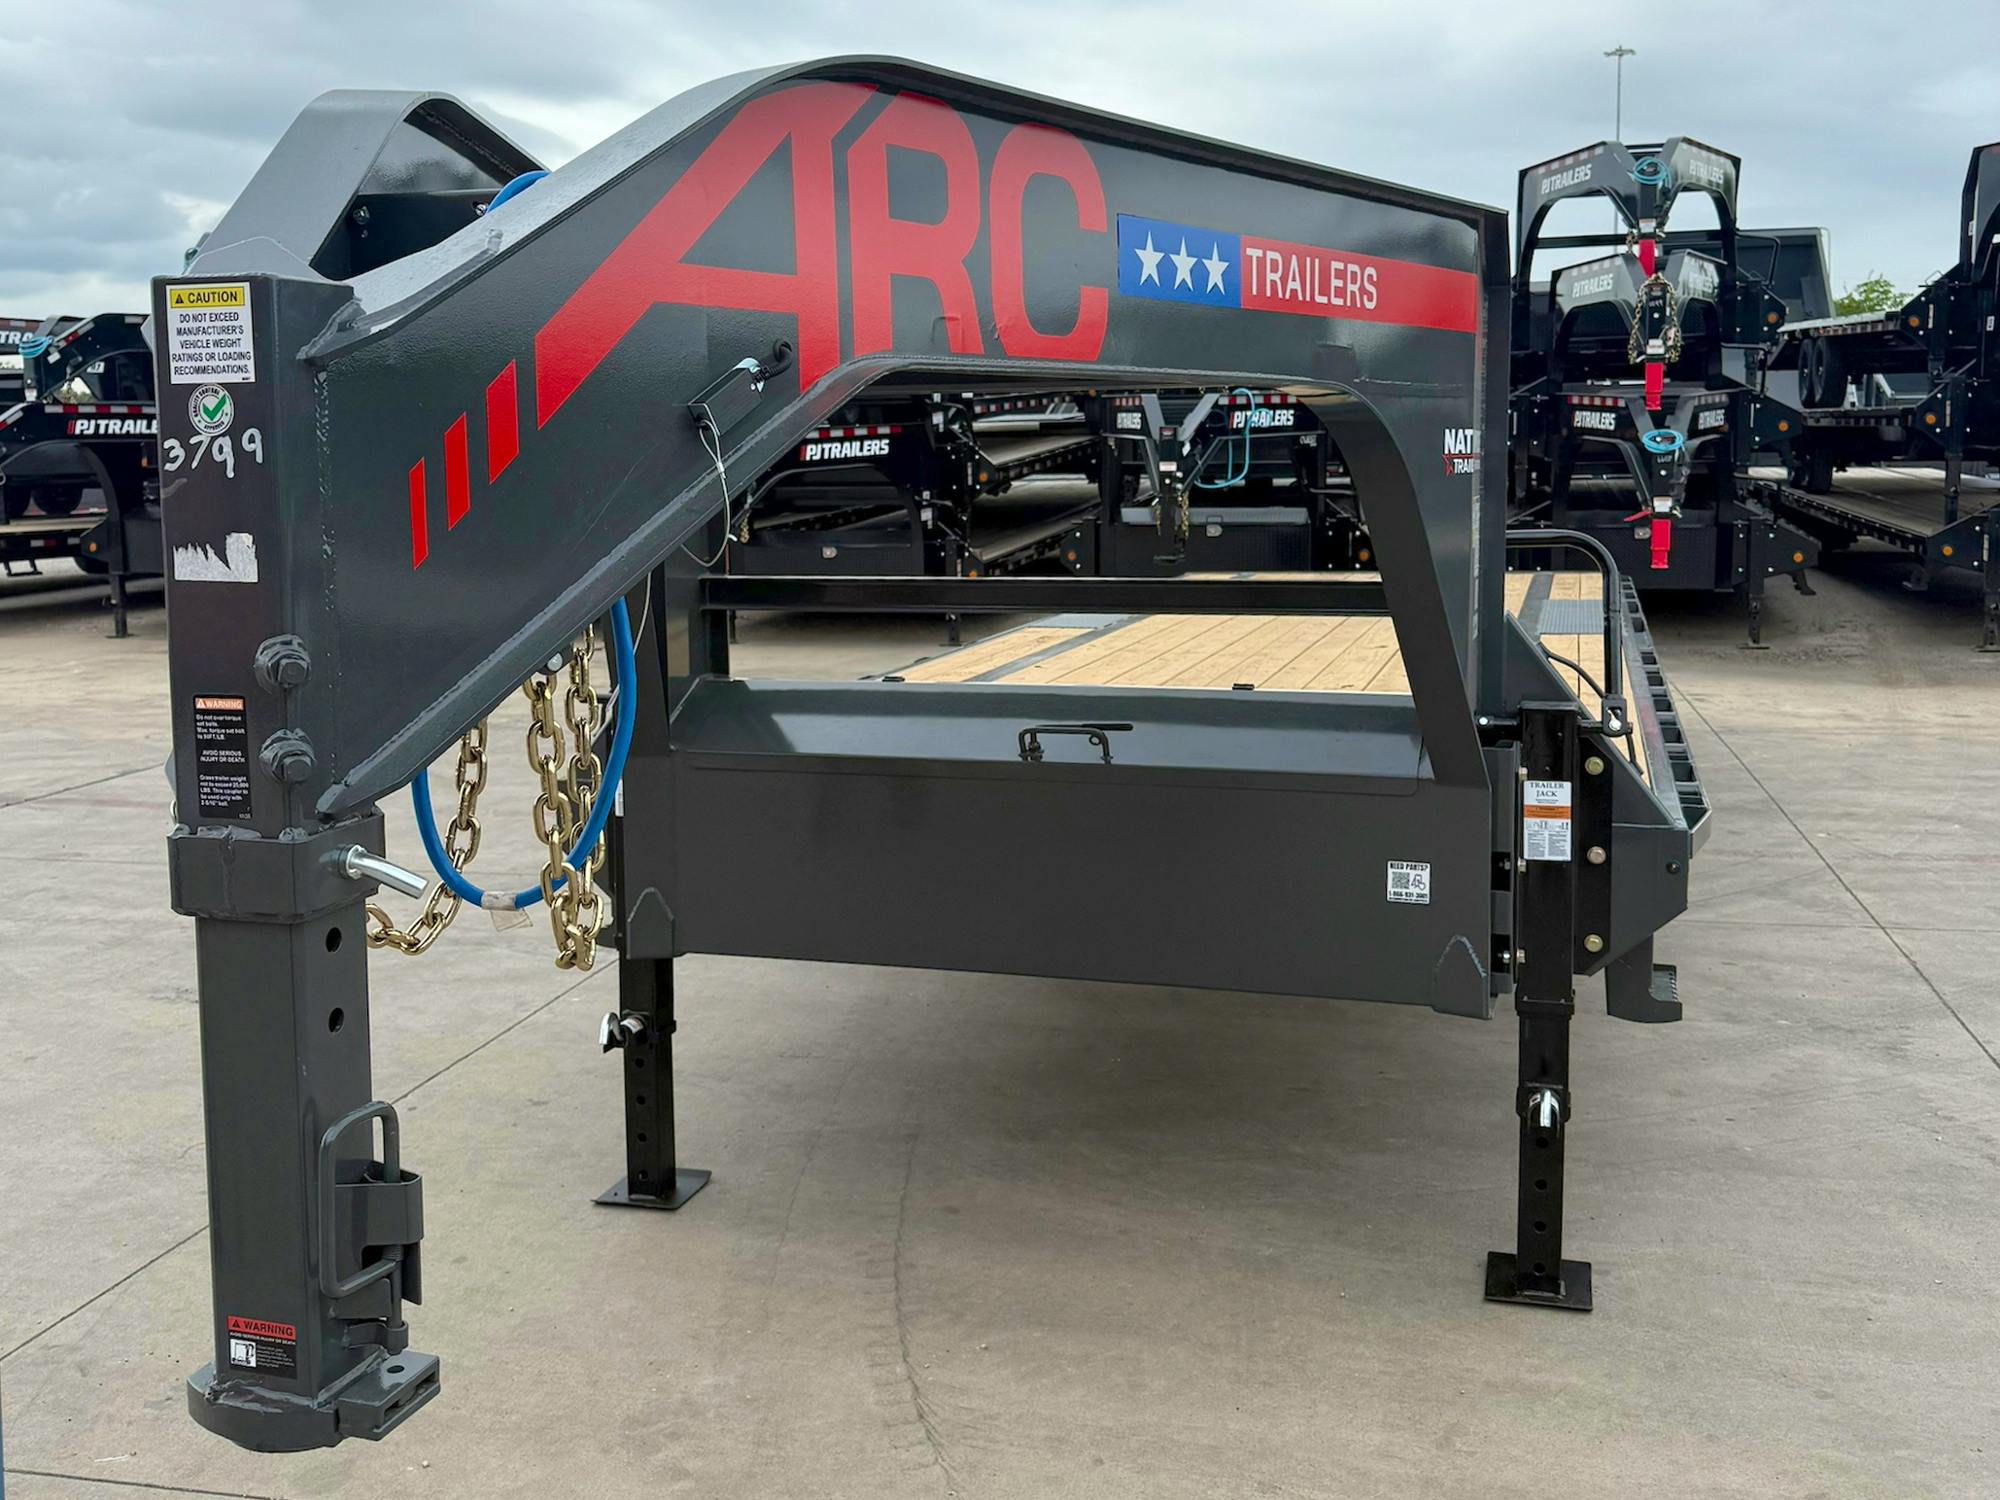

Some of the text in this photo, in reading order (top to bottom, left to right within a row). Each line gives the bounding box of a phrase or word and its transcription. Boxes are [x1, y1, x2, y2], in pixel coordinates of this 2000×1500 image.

[535, 83, 1108, 430] ARC
[1246, 247, 1378, 309] TRAILERS
[187, 291, 238, 304] CAUTION
[179, 312, 239, 323] DO NOT EXCEED
[176, 325, 244, 336] MANUFACTURER'S
[180, 338, 241, 349] VEHICLE WEIGHT
[172, 351, 252, 362] RATINGS OR LOADING
[243, 1320, 293, 1336] WARNING
